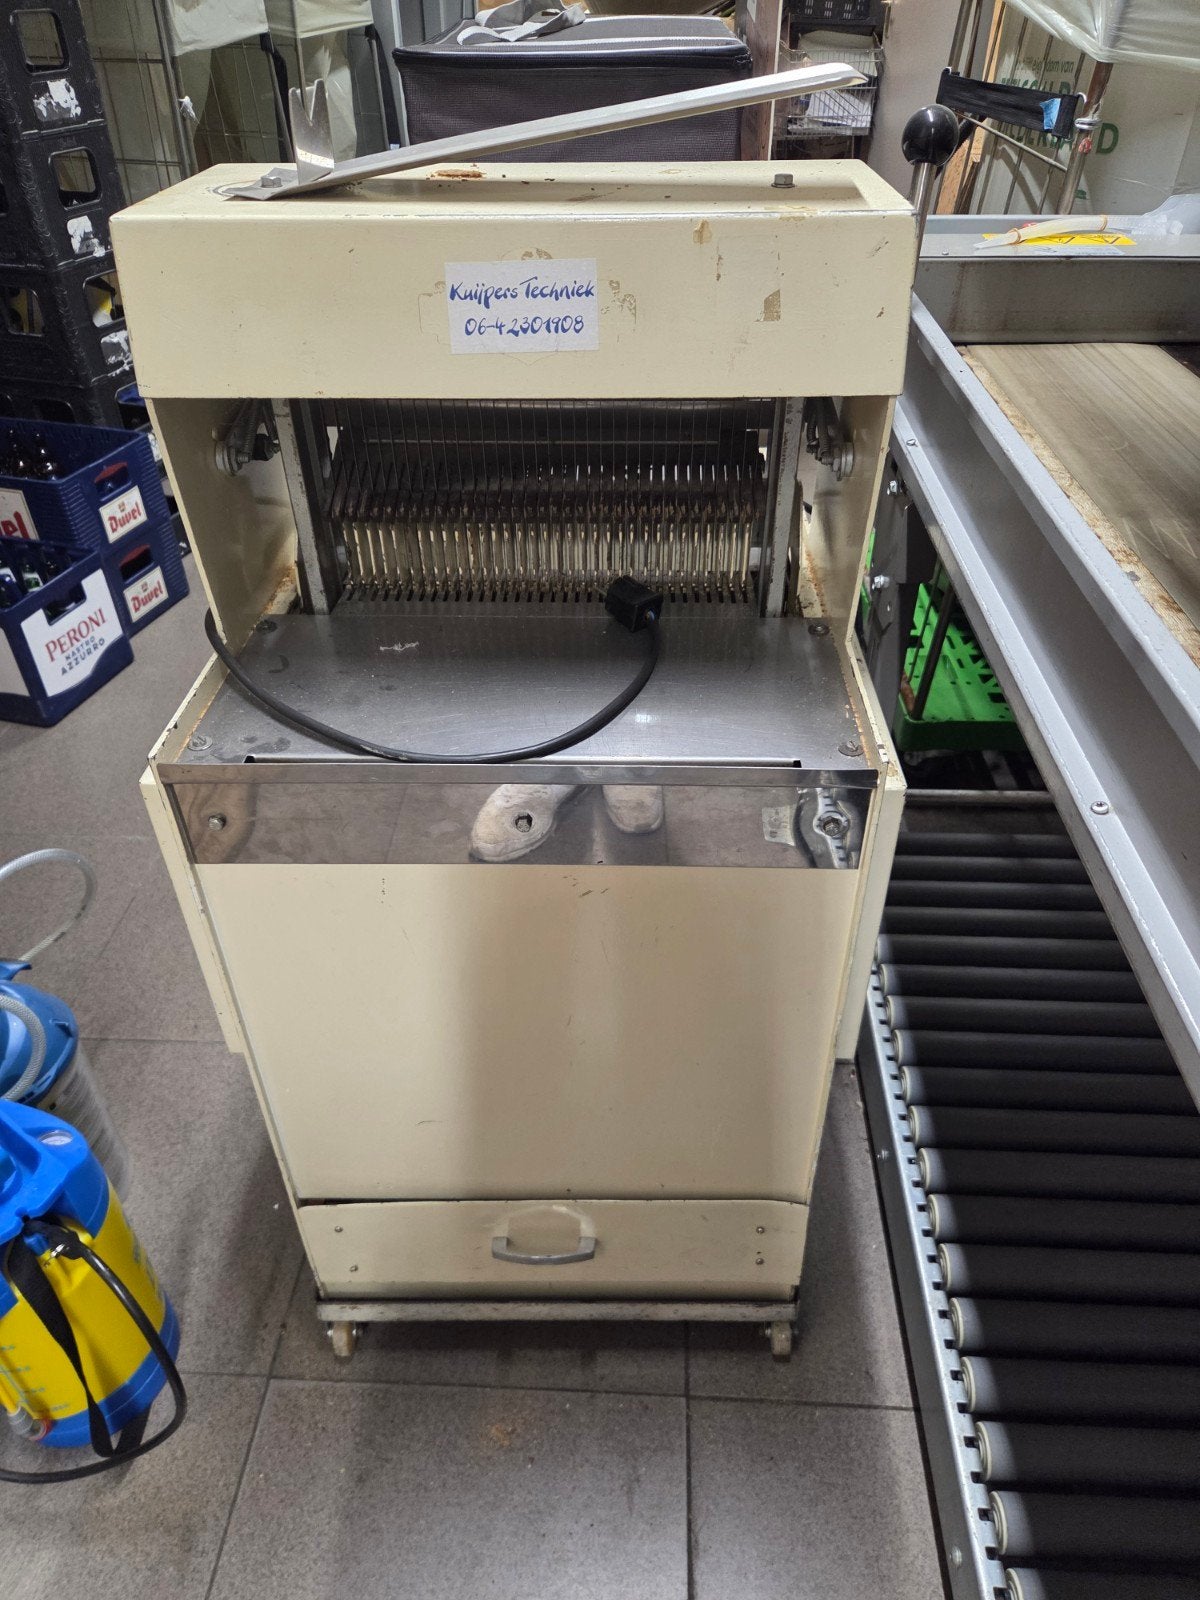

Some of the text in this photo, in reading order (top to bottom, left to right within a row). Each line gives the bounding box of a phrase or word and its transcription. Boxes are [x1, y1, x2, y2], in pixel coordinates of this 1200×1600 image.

[449, 276, 595, 309] Kuijpers Techniek
[108, 502, 142, 533] Duvel
[131, 581, 163, 613] Duvel
[45, 607, 106, 663] PERONI
[65, 635, 96, 661] NASTRO
[61, 637, 105, 676] AZZURRO
